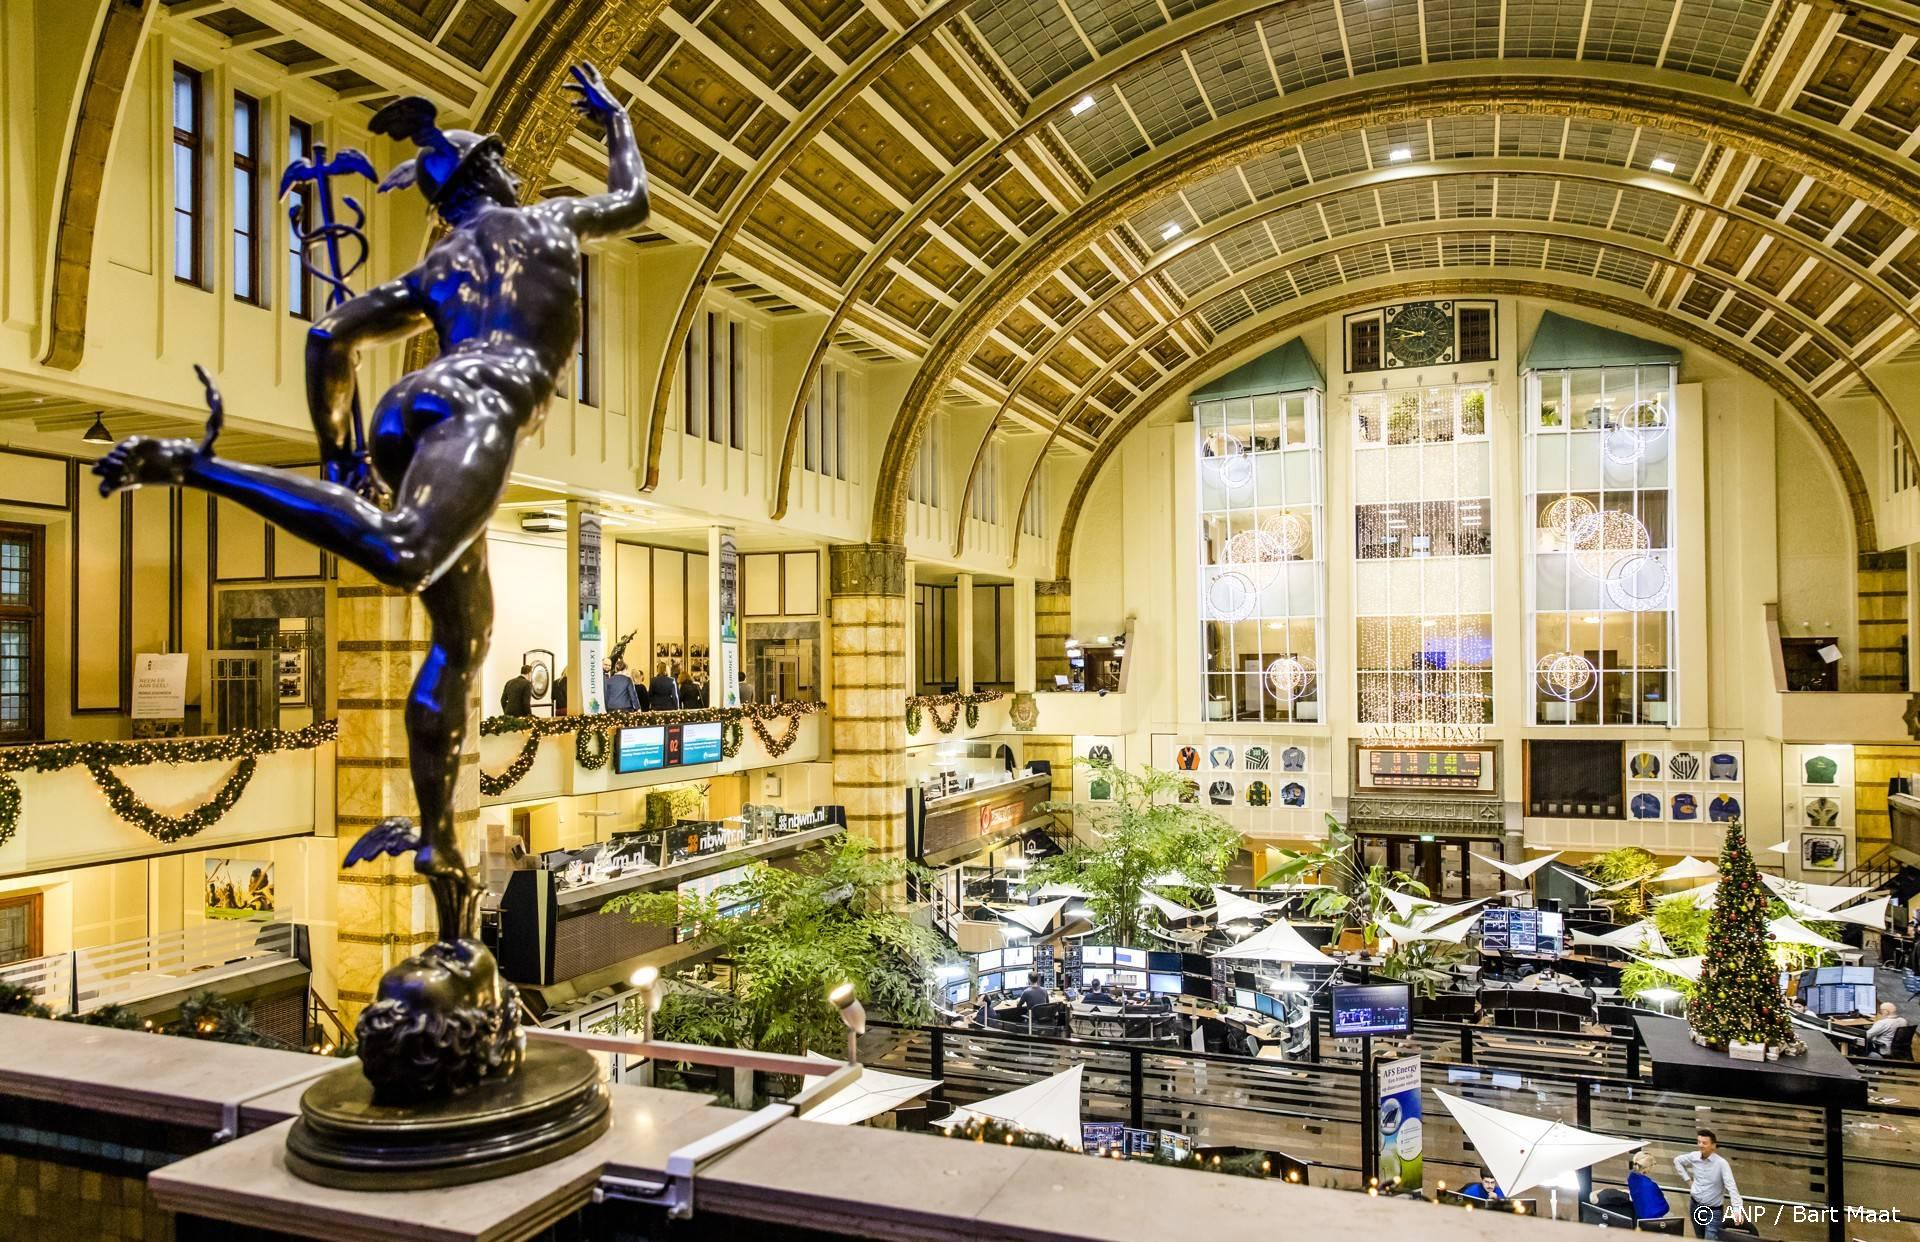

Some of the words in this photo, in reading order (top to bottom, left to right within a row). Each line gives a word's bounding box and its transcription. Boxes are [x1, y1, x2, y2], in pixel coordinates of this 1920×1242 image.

[1368, 725, 1484, 739] AMSTERDAM
[669, 739, 678, 753] 02
[788, 806, 825, 829] nbwm.nl
[700, 823, 746, 851] nbwm.nl
[1383, 1068, 1395, 1079] AFS
[1396, 1064, 1417, 1075] Energy
